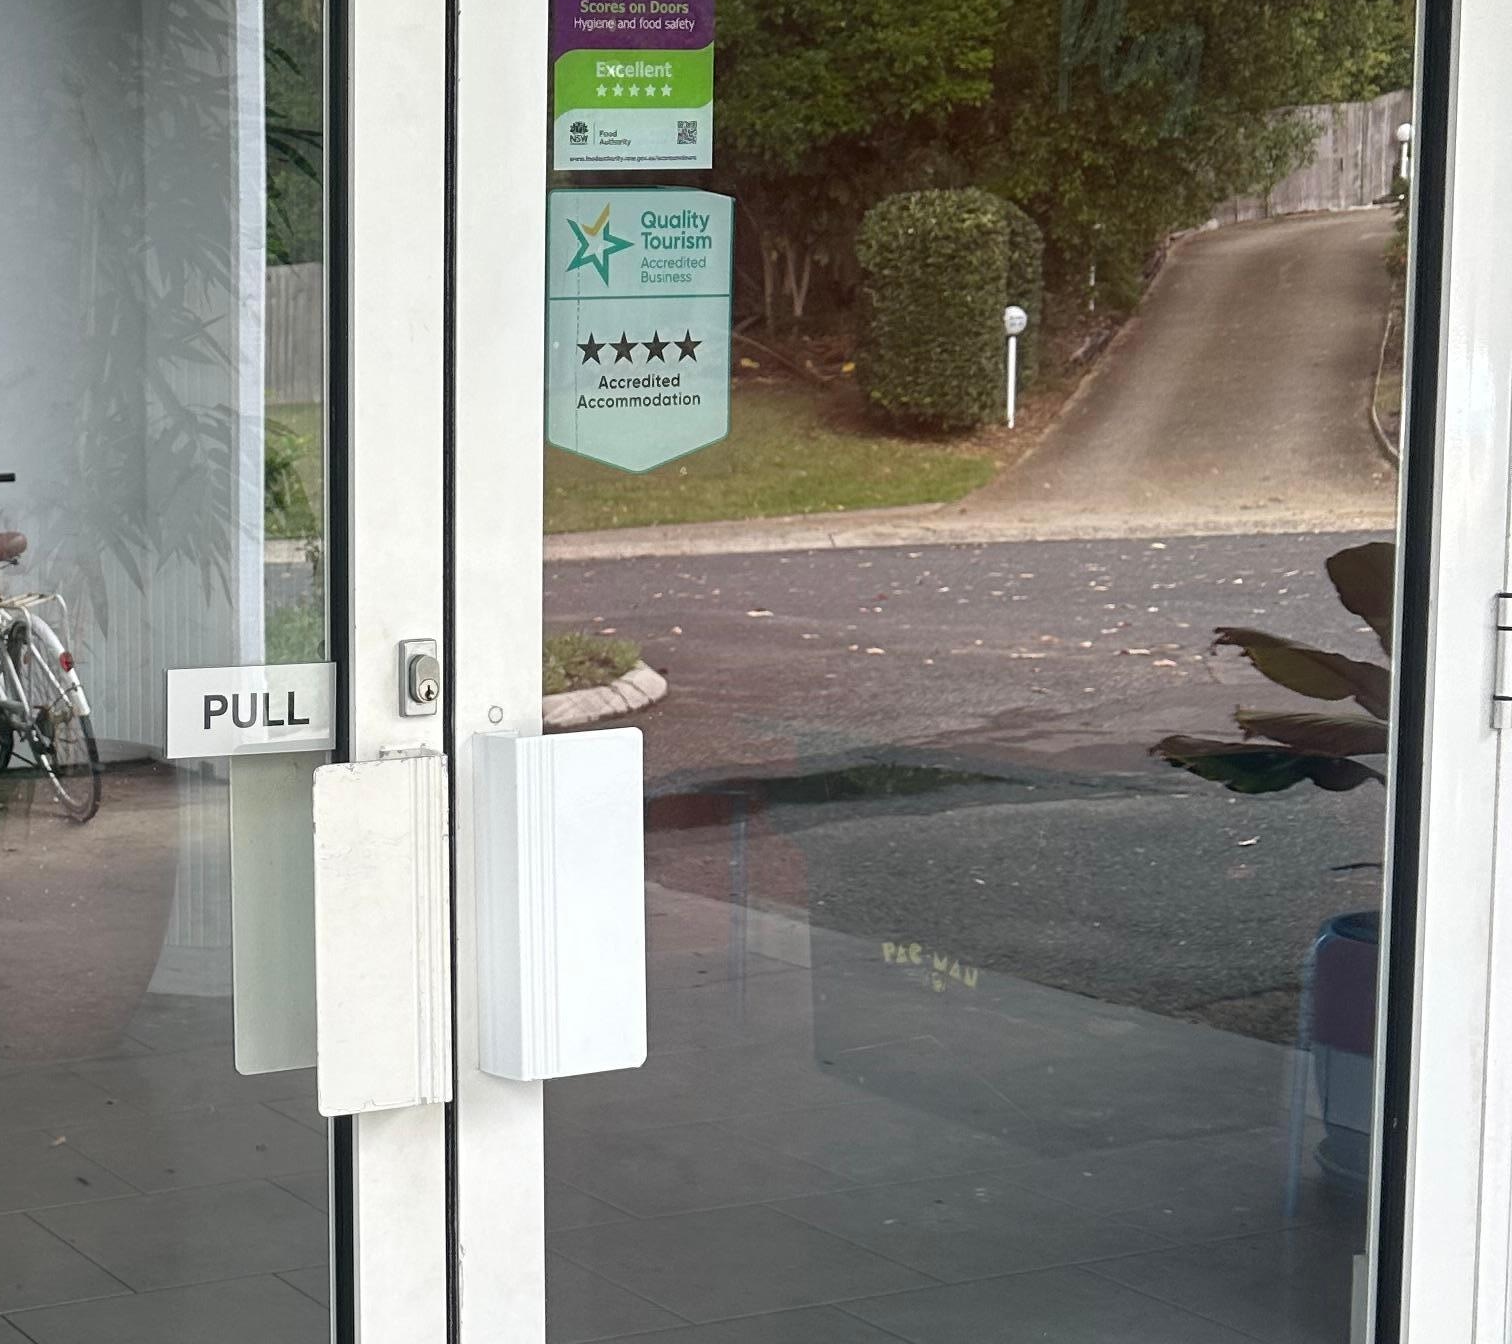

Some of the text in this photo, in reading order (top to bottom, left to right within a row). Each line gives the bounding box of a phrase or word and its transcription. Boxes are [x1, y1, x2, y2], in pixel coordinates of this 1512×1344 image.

[580, 0, 689, 14] Scores on Doors
[574, 17, 695, 32] Hygiene and food safety
[596, 61, 673, 78] Excellent
[569, 135, 589, 144] NSW
[599, 130, 618, 138] Food
[641, 209, 711, 233] Quality
[641, 231, 712, 250] Tourism
[640, 256, 707, 269] Accredited
[641, 271, 692, 284] Business
[598, 373, 681, 390] Accredited
[577, 393, 701, 410] Accommodation
[202, 690, 310, 731] PULL
